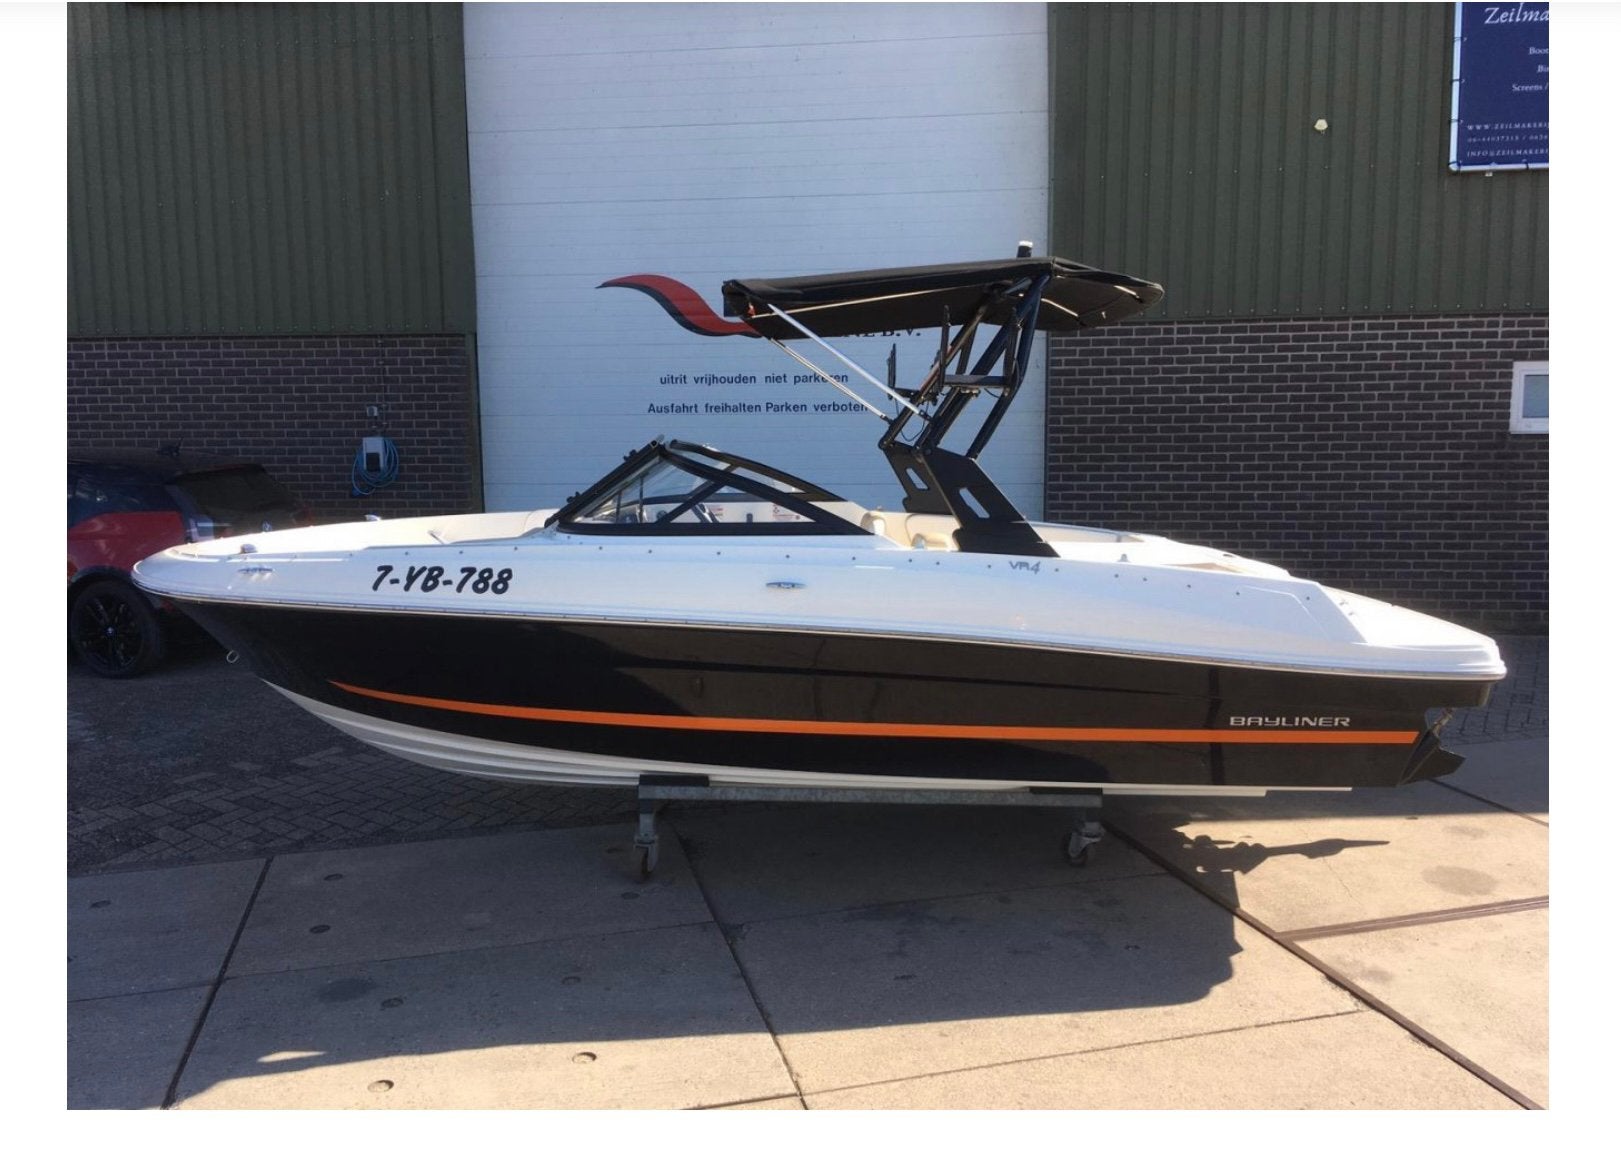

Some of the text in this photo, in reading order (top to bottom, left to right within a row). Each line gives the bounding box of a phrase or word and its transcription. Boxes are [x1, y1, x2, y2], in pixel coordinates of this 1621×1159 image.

[1512, 83, 1542, 91] Screens
[660, 373, 848, 386] uitrit vrijhouden niet parkeen
[648, 401, 868, 414] Ausfahrt freihalten Parken verboten
[372, 565, 513, 595] 7-YB-788
[1230, 716, 1350, 727] BAYLINER
